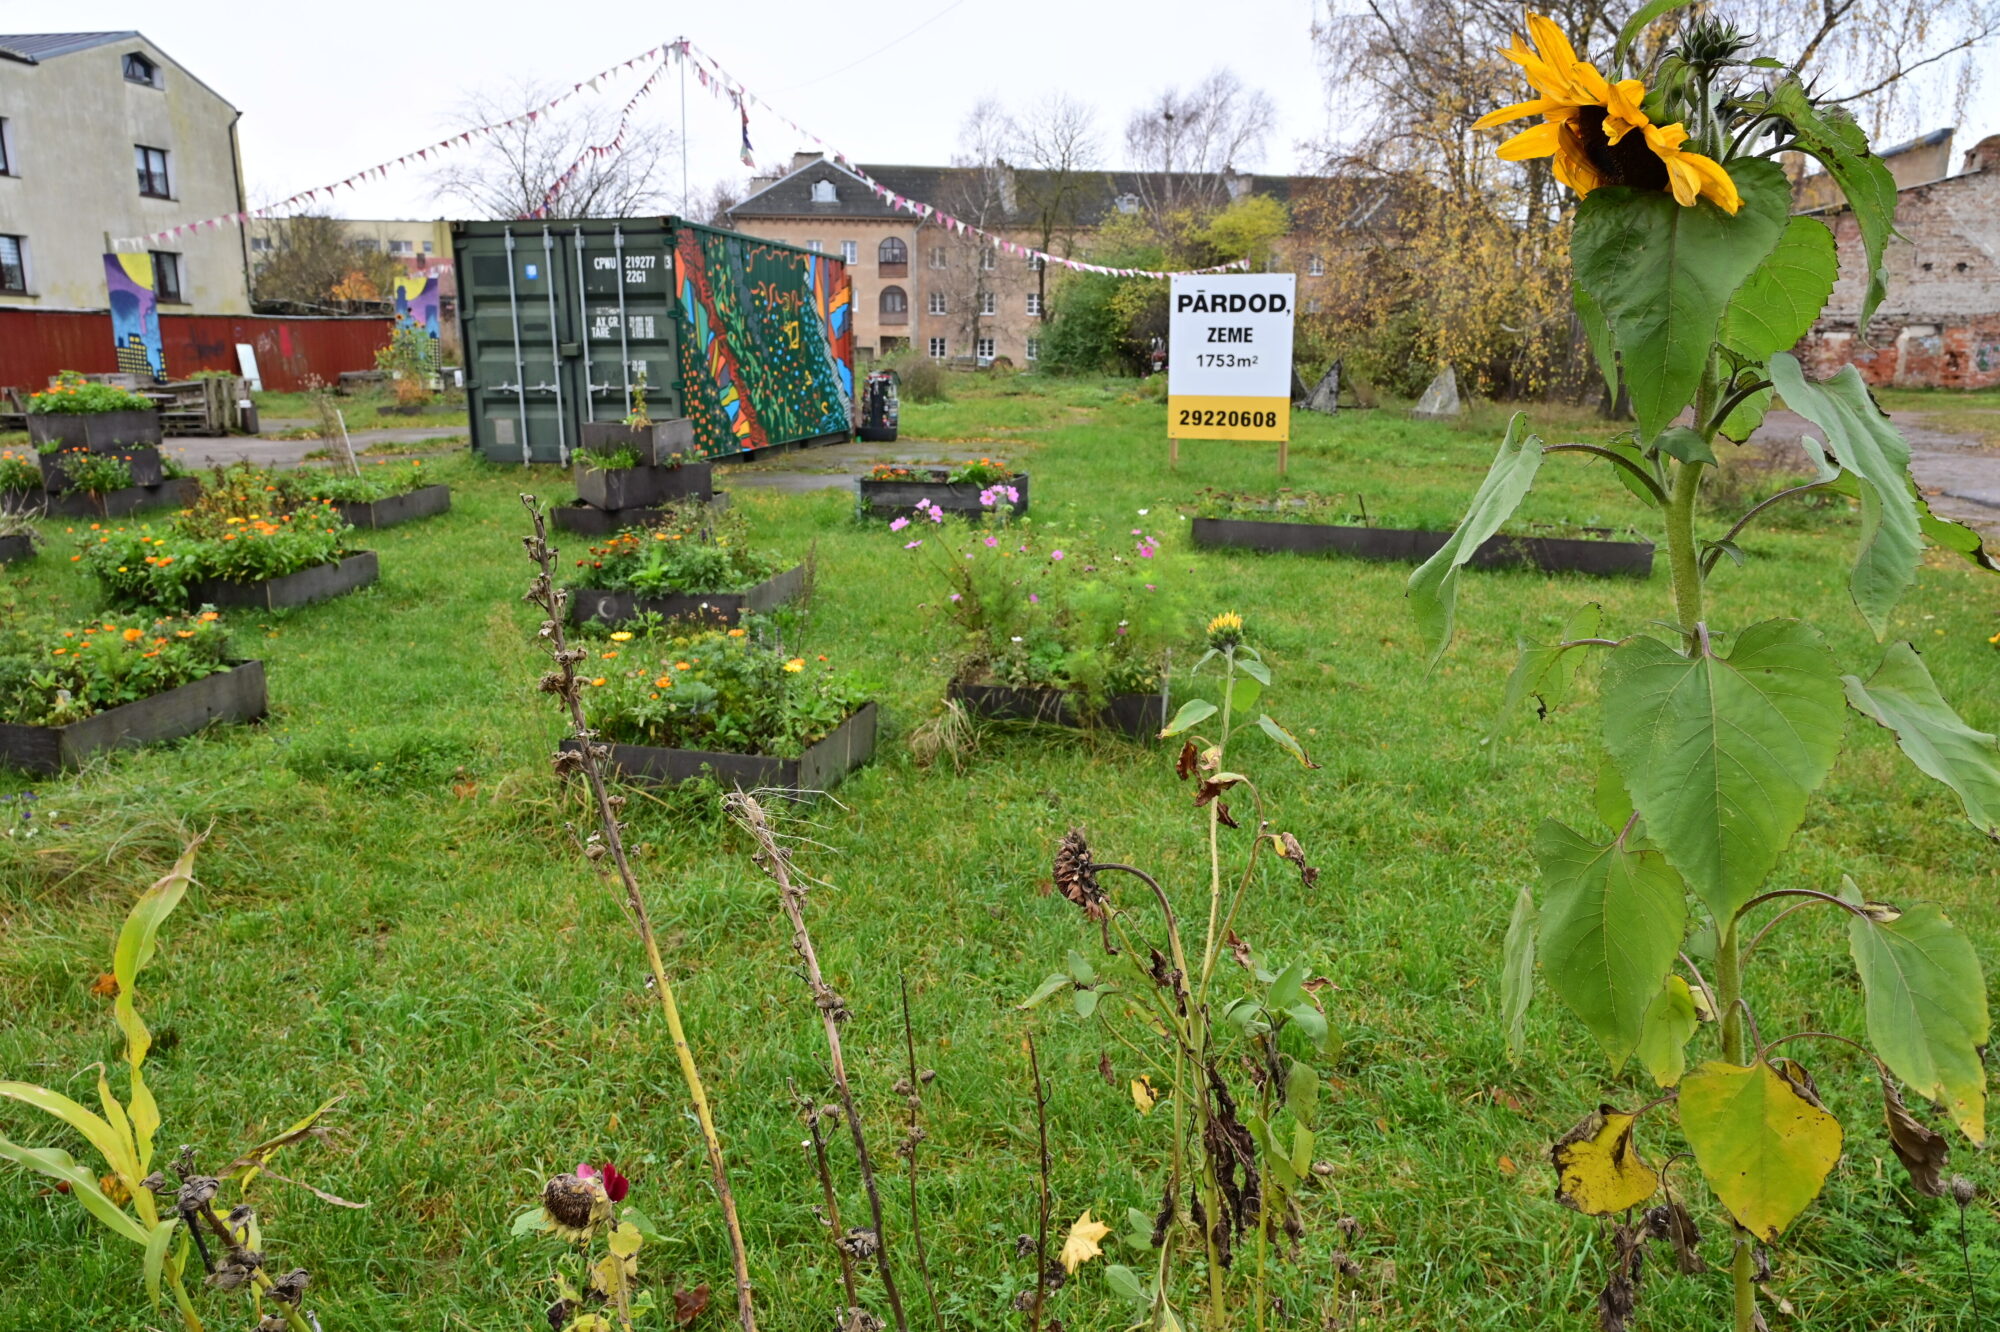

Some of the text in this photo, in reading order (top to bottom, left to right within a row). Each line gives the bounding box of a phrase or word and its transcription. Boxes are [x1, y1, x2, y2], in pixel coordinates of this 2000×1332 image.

[625, 256, 656, 269] 219277
[626, 270, 647, 283] 22G1
[1178, 289, 1291, 317] PĀRDOD,
[1207, 327, 1253, 343] ZEME
[1180, 409, 1276, 427] 29220608
